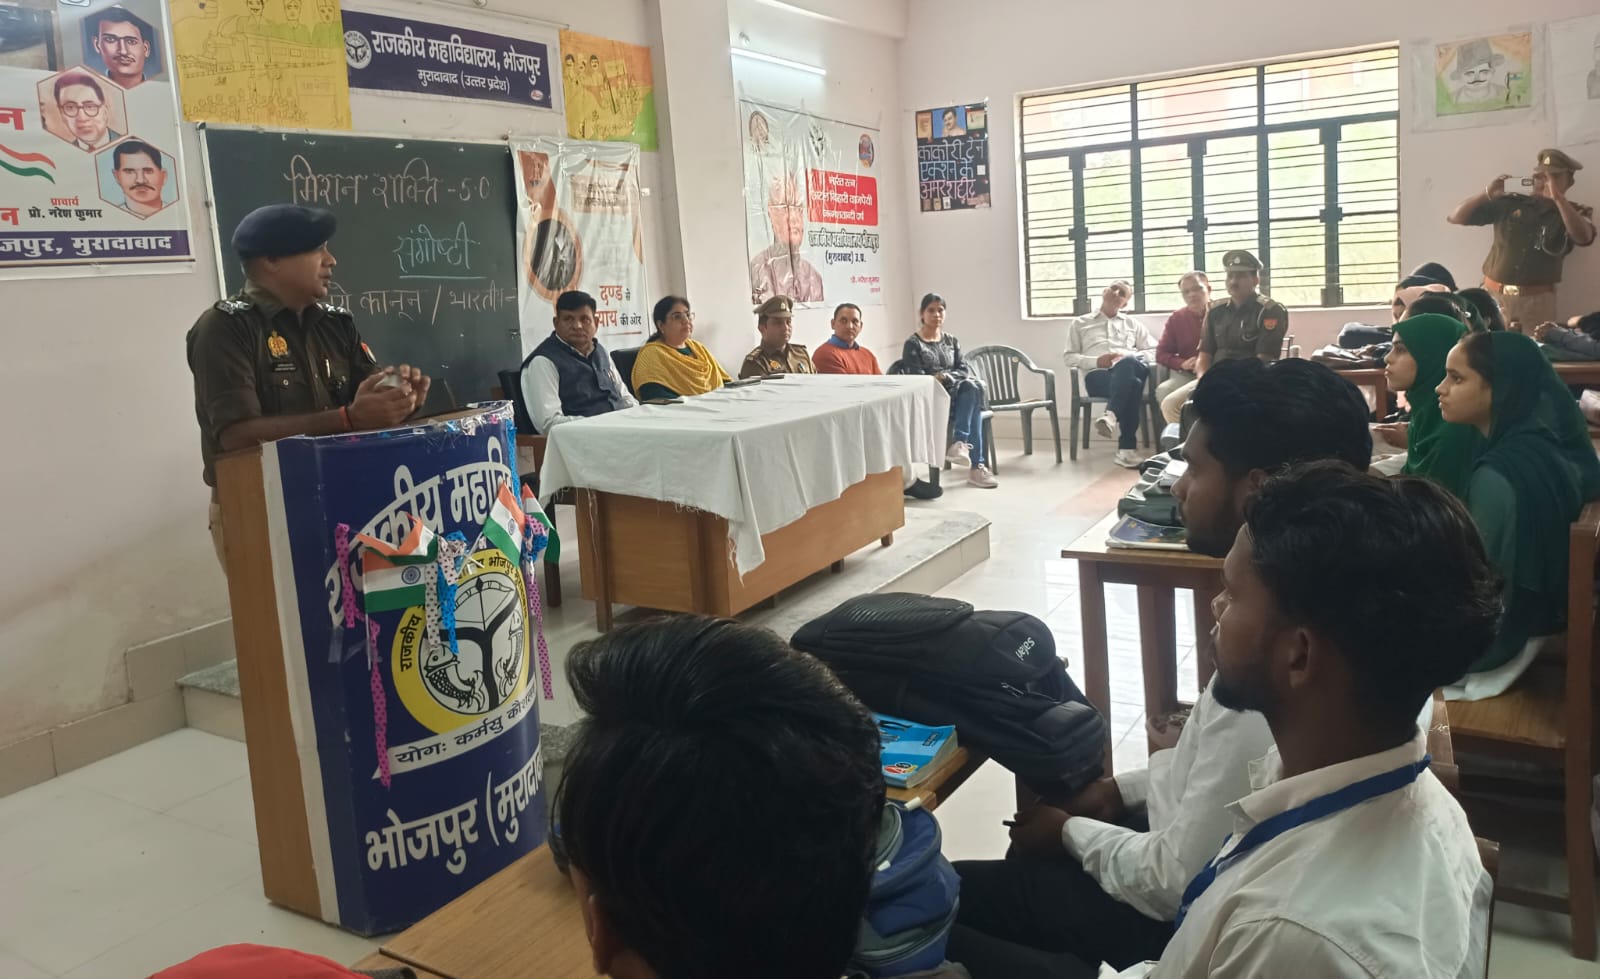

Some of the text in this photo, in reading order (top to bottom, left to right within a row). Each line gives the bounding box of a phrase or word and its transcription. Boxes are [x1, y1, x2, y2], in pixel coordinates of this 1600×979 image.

[370, 25, 542, 86] राजकीय महाविद्यालय, भोजपुर
[416, 68, 459, 87] मुरादाबाद
[460, 70, 487, 90] (उत्तर
[487, 75, 511, 96] प्रदेश)
[918, 138, 966, 161] काकोरी
[283, 154, 368, 206] मिशन
[48, 206, 73, 219] नरेश
[75, 208, 103, 221] कुमार
[70, 235, 173, 257] मुरादाबाद
[599, 285, 623, 306] दण्ड
[620, 312, 629, 326] की
[400, 613, 423, 672] राजकीय
[453, 715, 505, 746] कर्मसु
[365, 797, 480, 875] भोजपुर
